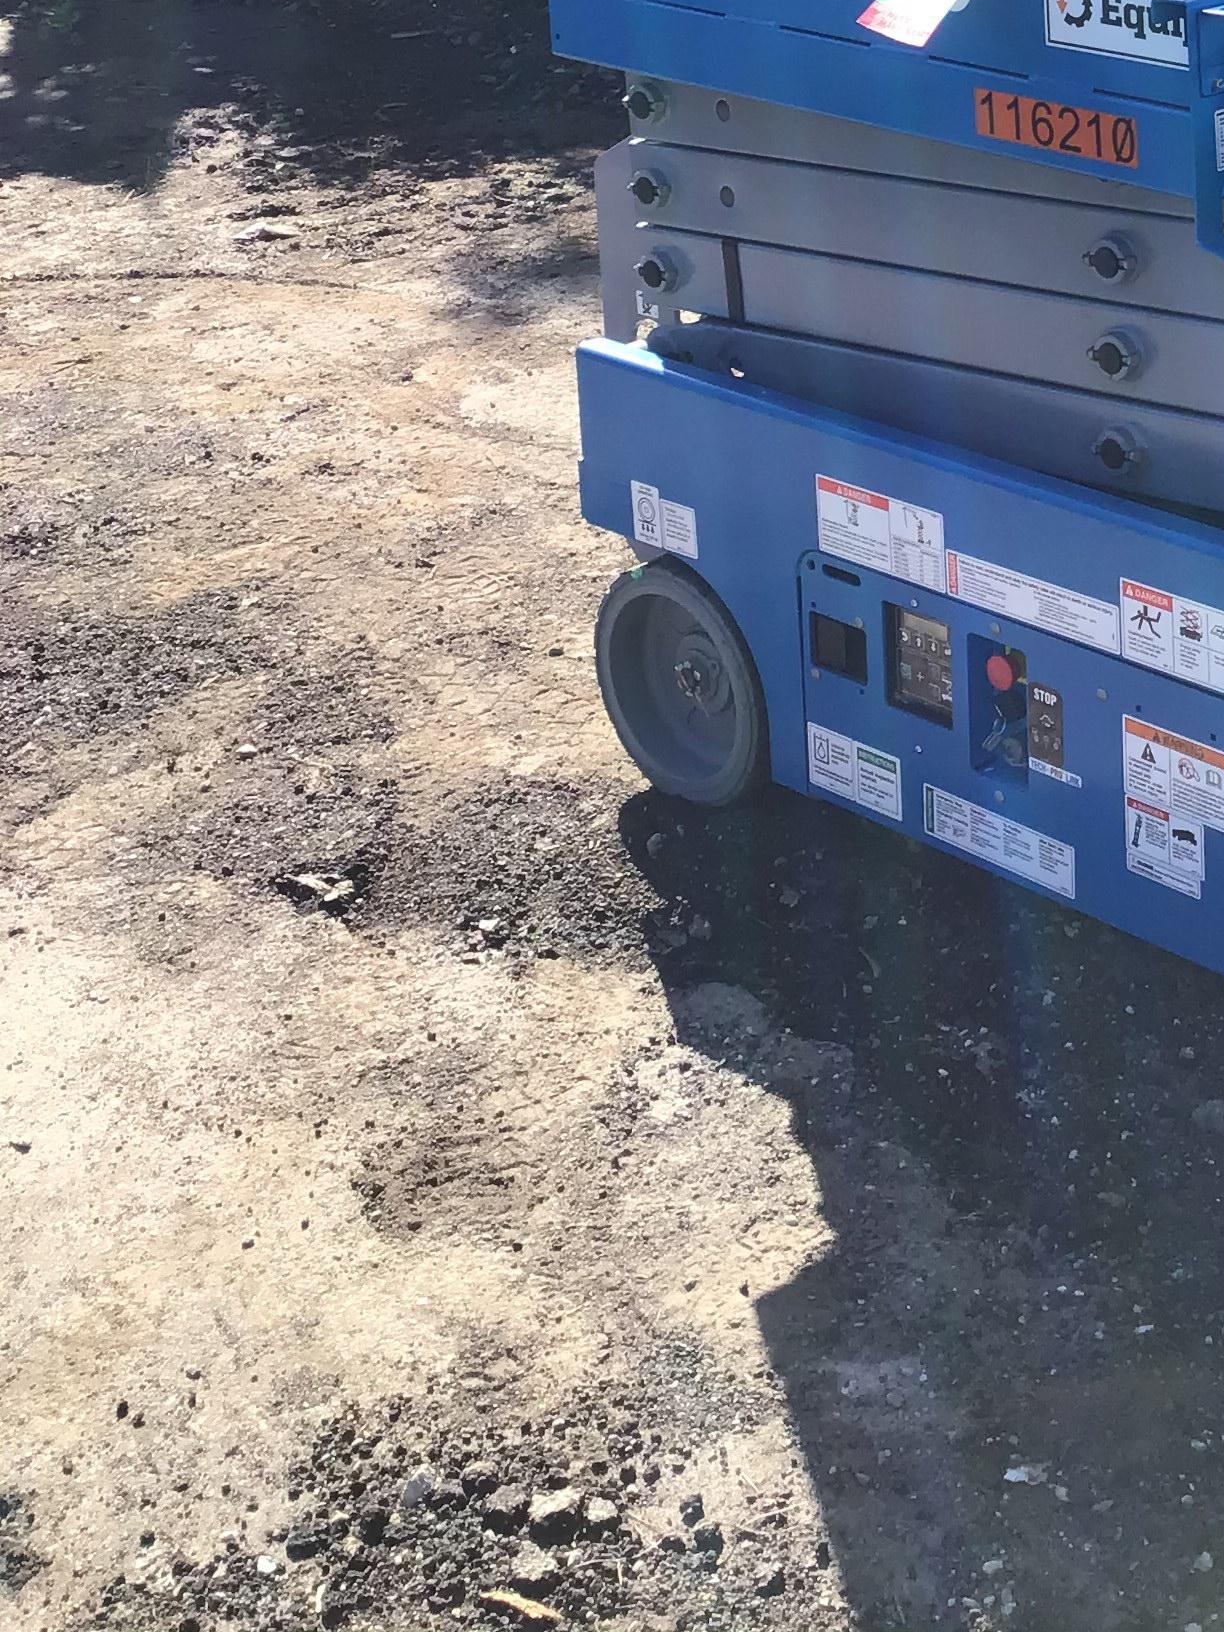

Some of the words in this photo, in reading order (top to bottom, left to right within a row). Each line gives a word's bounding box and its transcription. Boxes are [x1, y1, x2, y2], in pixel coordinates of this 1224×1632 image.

[980, 90, 1135, 164] 116210
[1134, 587, 1169, 607] DANGER
[1033, 687, 1058, 706] STOP
